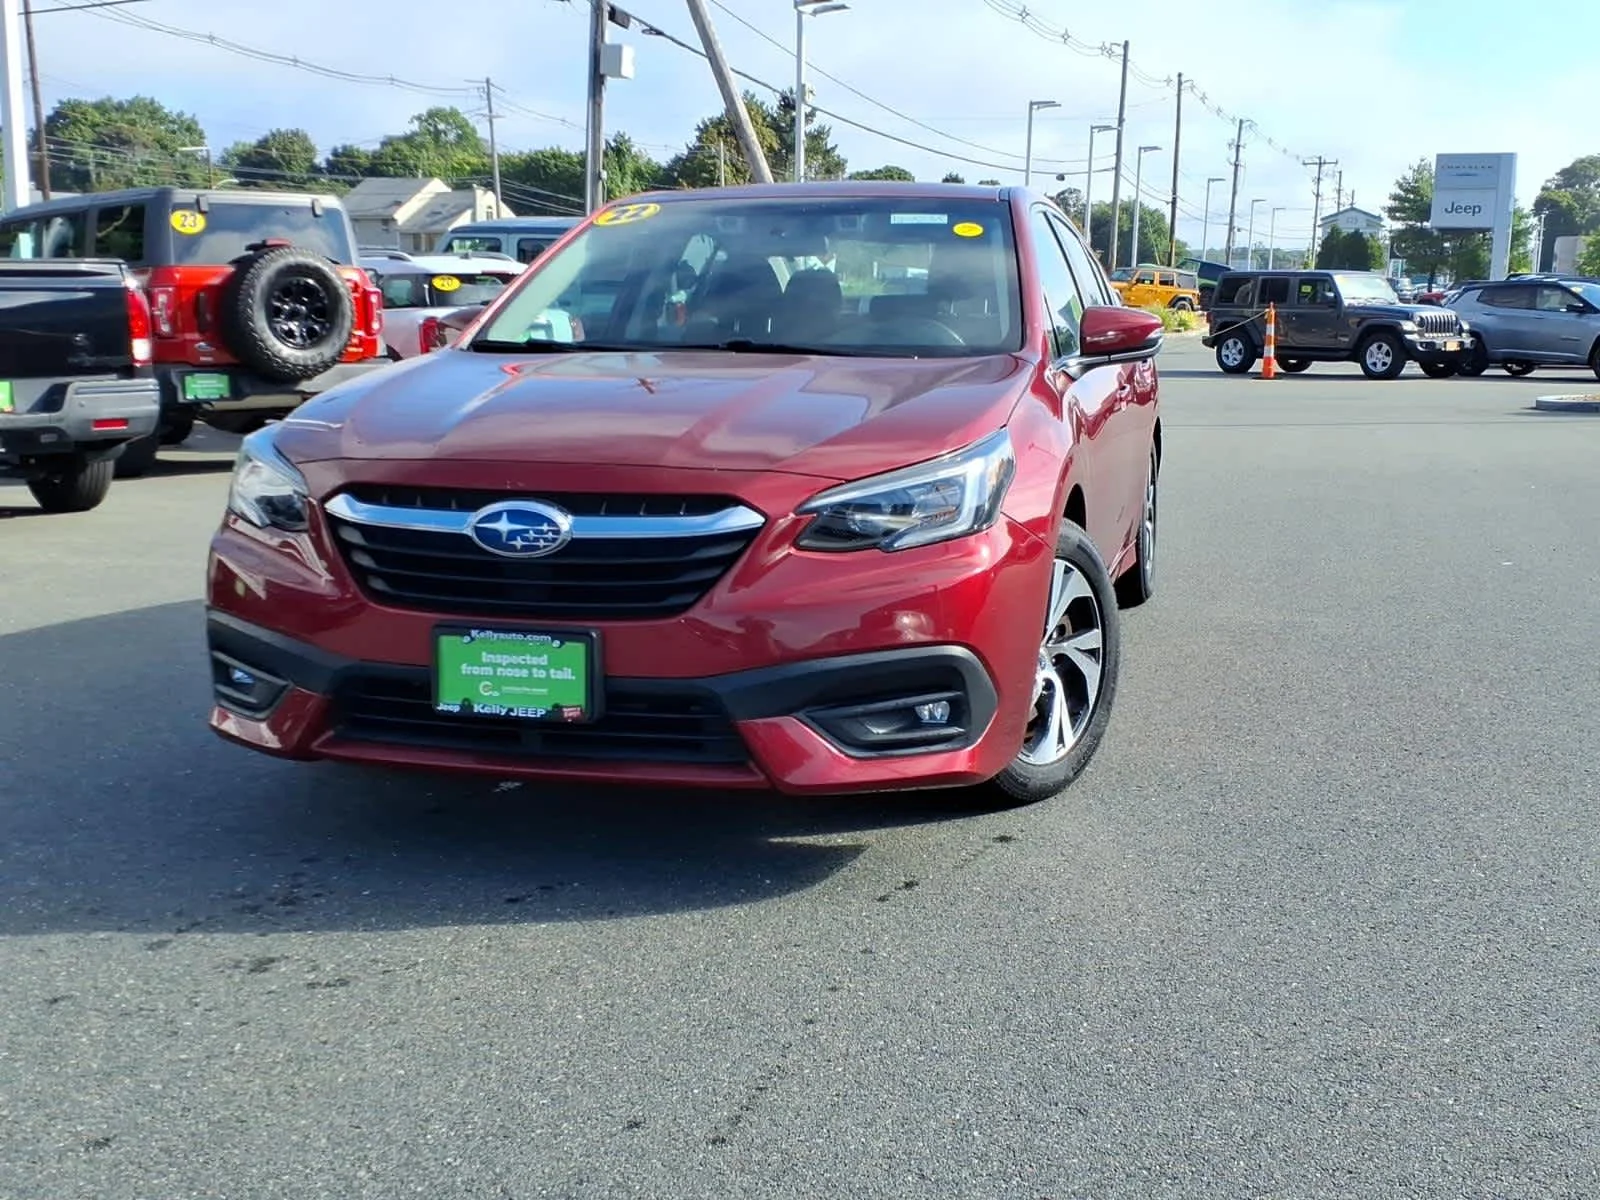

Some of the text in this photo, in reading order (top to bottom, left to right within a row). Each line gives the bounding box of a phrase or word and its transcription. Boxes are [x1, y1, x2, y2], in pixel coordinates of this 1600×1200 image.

[1444, 201, 1482, 216] Jeep
[180, 214, 197, 228] 23
[470, 629, 551, 642] Kellyauto.com
[481, 652, 549, 666] Inspected
[460, 663, 576, 680] from nose to tail.
[473, 703, 508, 716] Kelly
[510, 705, 547, 718] JEEP
